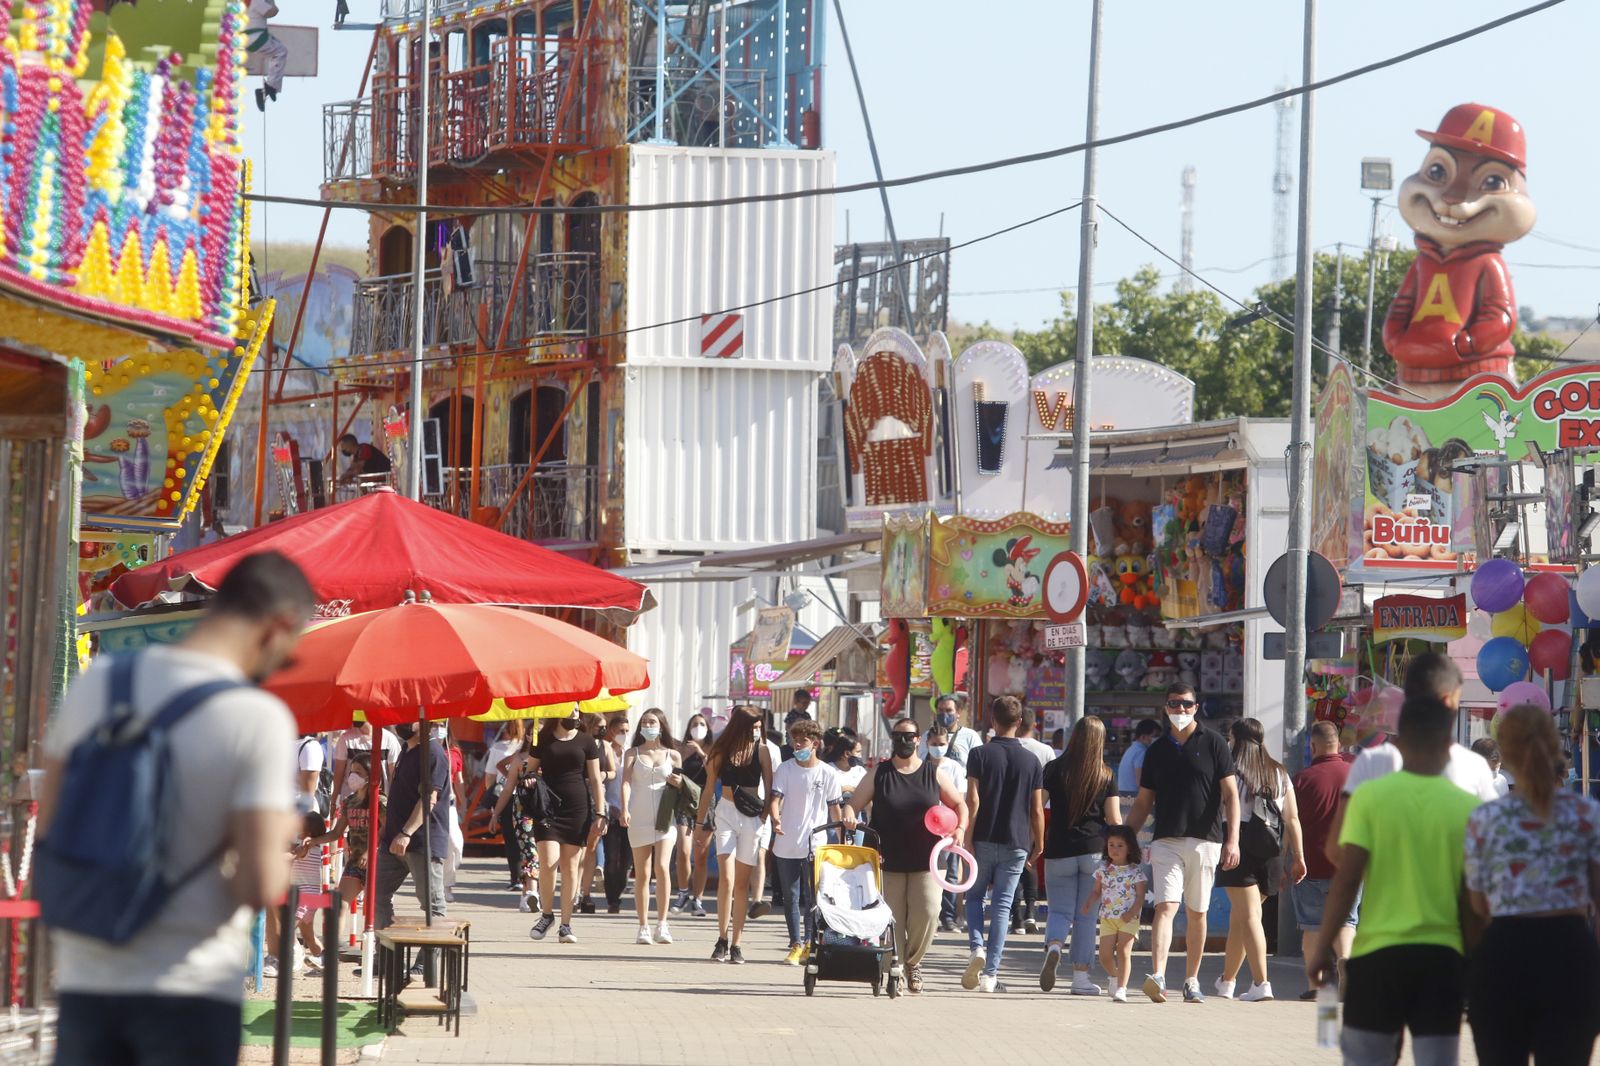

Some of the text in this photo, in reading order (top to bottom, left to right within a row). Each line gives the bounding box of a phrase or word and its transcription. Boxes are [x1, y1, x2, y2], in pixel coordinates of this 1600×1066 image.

[1464, 110, 1495, 145] A
[1412, 273, 1462, 324] A
[1373, 517, 1450, 544] Buñu
[1380, 605, 1459, 627] ENTRADA
[1048, 638, 1055, 646] DE
[1051, 628, 1059, 636] EN
